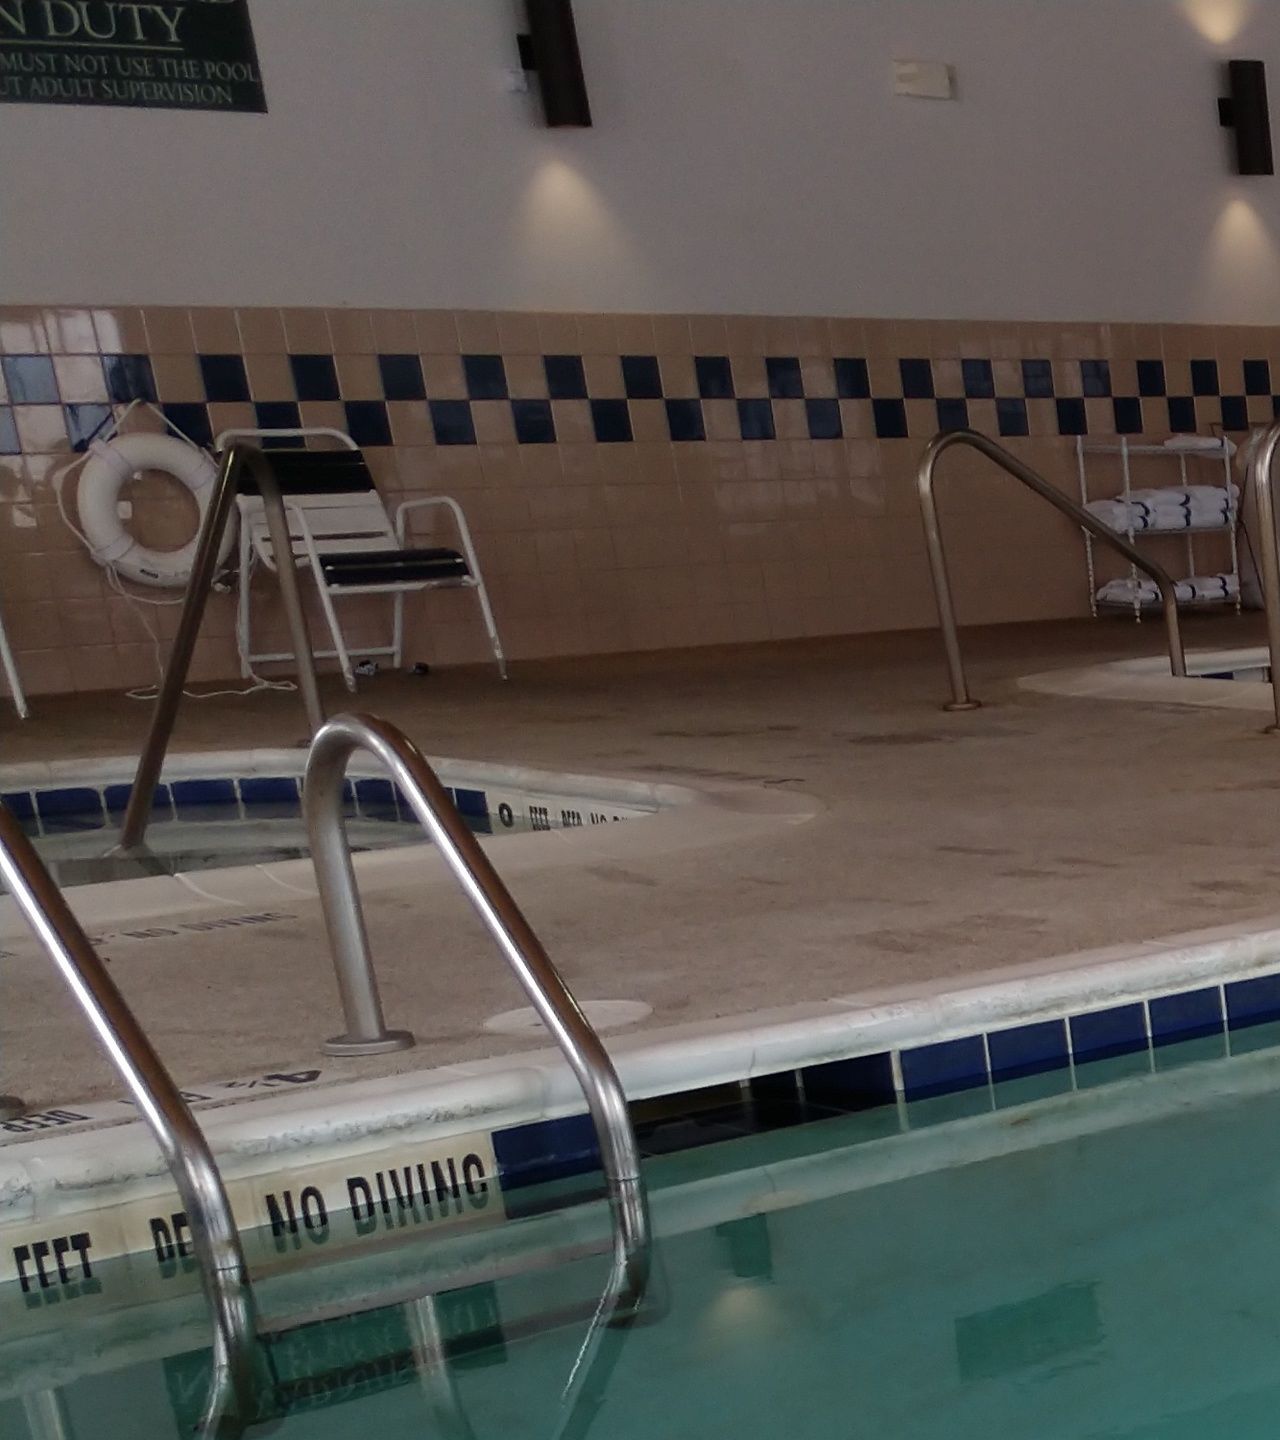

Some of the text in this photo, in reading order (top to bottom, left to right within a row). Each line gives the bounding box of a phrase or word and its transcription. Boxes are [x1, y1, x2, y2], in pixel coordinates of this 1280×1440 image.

[45, 0, 185, 43] DUTY
[1, 52, 260, 82] MUST NOT USE THE POOL
[29, 78, 96, 98] ADULT
[102, 80, 234, 104] SUPERVISION
[13, 1232, 98, 1299] FEET
[265, 1186, 329, 1244] NO
[346, 1154, 489, 1229] DIVING
